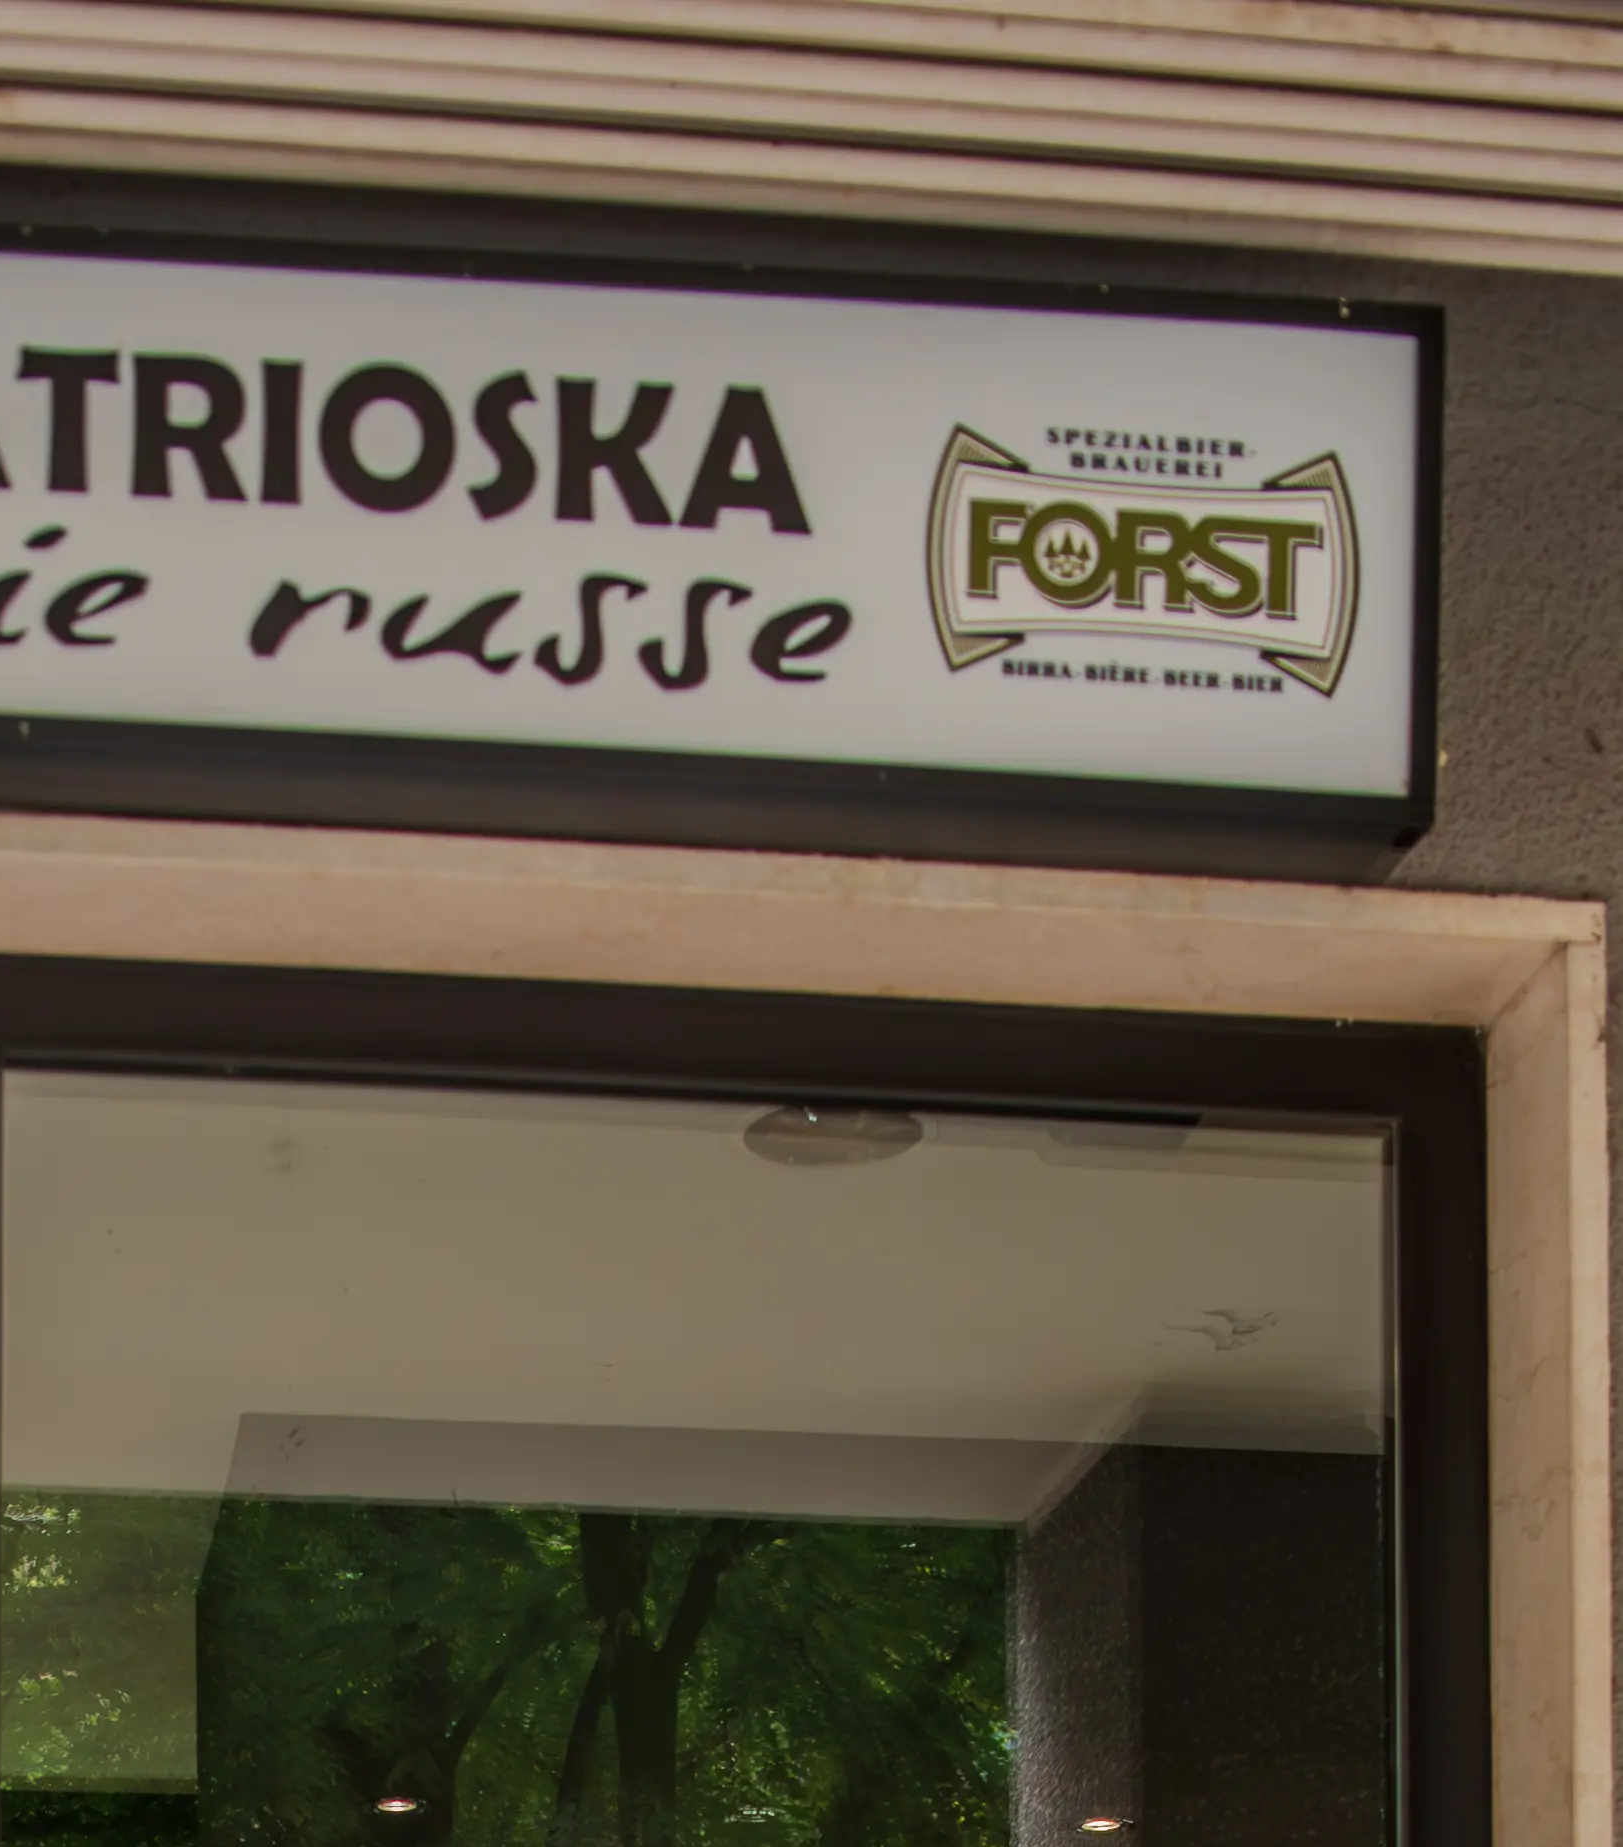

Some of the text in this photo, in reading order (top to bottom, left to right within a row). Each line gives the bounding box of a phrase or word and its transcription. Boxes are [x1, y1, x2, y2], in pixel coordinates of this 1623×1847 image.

[1068, 452, 1225, 480] BRAUEREI
[964, 495, 1325, 622] FORST
[247, 570, 854, 693] russe
